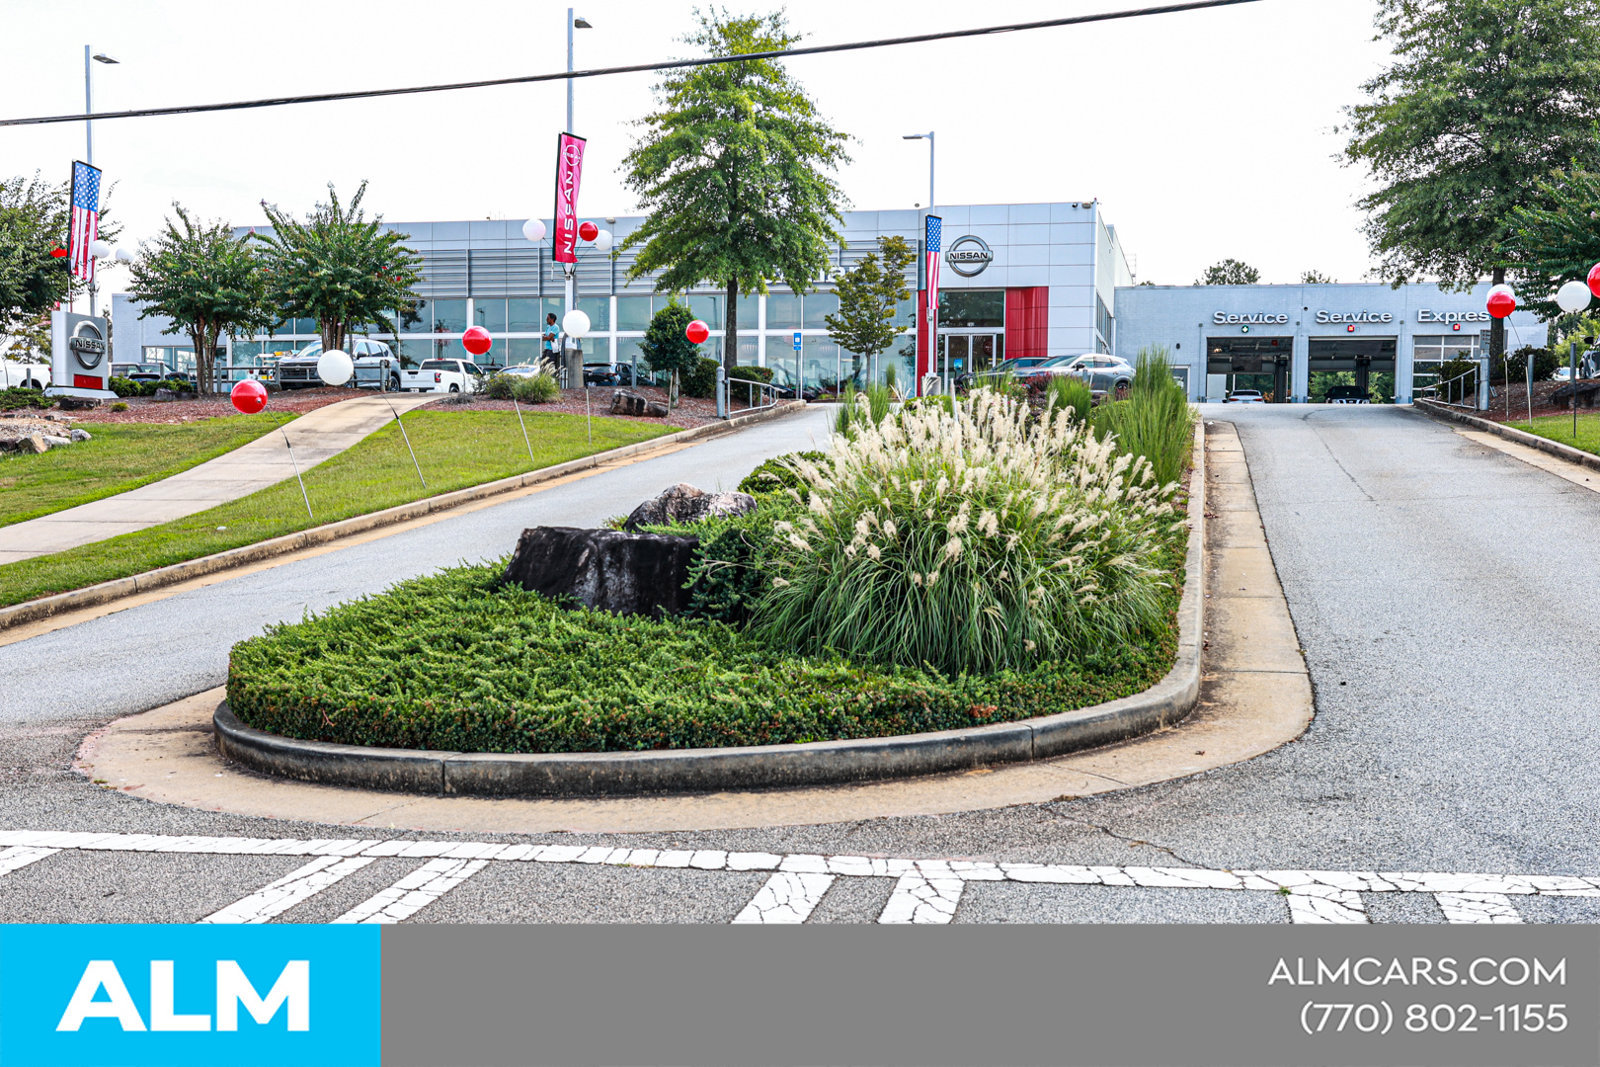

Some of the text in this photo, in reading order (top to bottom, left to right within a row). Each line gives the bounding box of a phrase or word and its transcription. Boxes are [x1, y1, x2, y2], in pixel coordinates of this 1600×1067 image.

[563, 171, 574, 254] NISSAN
[1213, 310, 1289, 324] Service
[1316, 309, 1393, 324] Service
[1417, 308, 1491, 325] Expres
